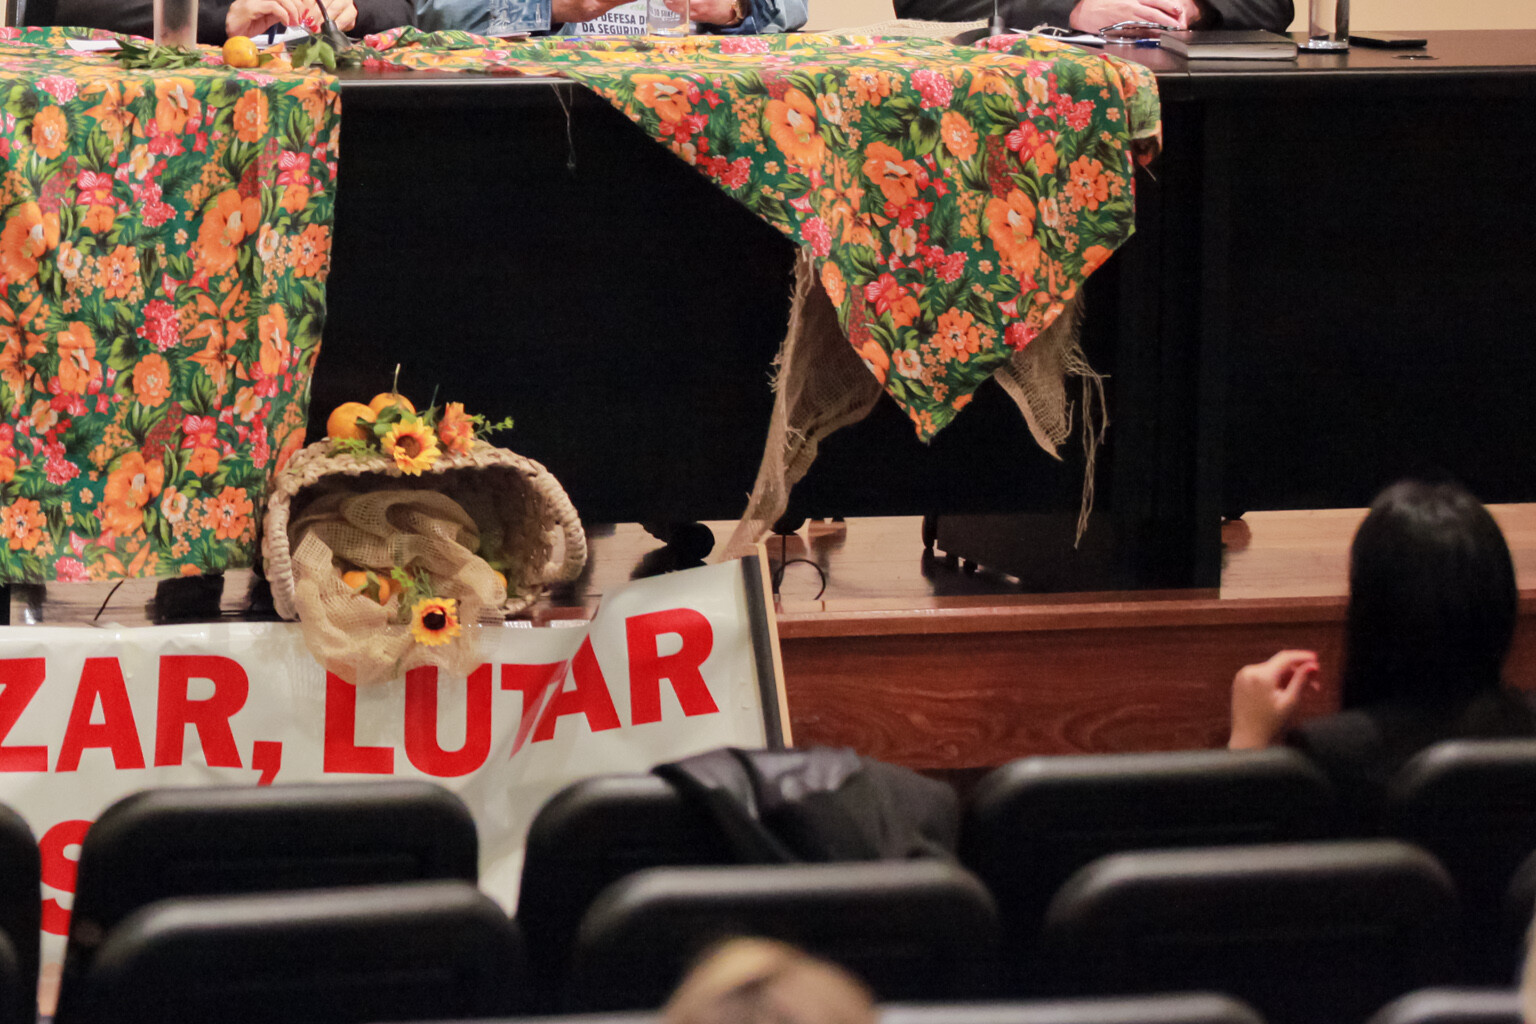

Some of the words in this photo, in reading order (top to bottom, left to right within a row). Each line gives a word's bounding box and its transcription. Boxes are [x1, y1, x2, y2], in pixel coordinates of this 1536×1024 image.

[601, 13, 637, 25] DEFESA
[581, 22, 596, 33] DA
[597, 23, 646, 36] SEGURIDA
[322, 607, 720, 778] LUTAR
